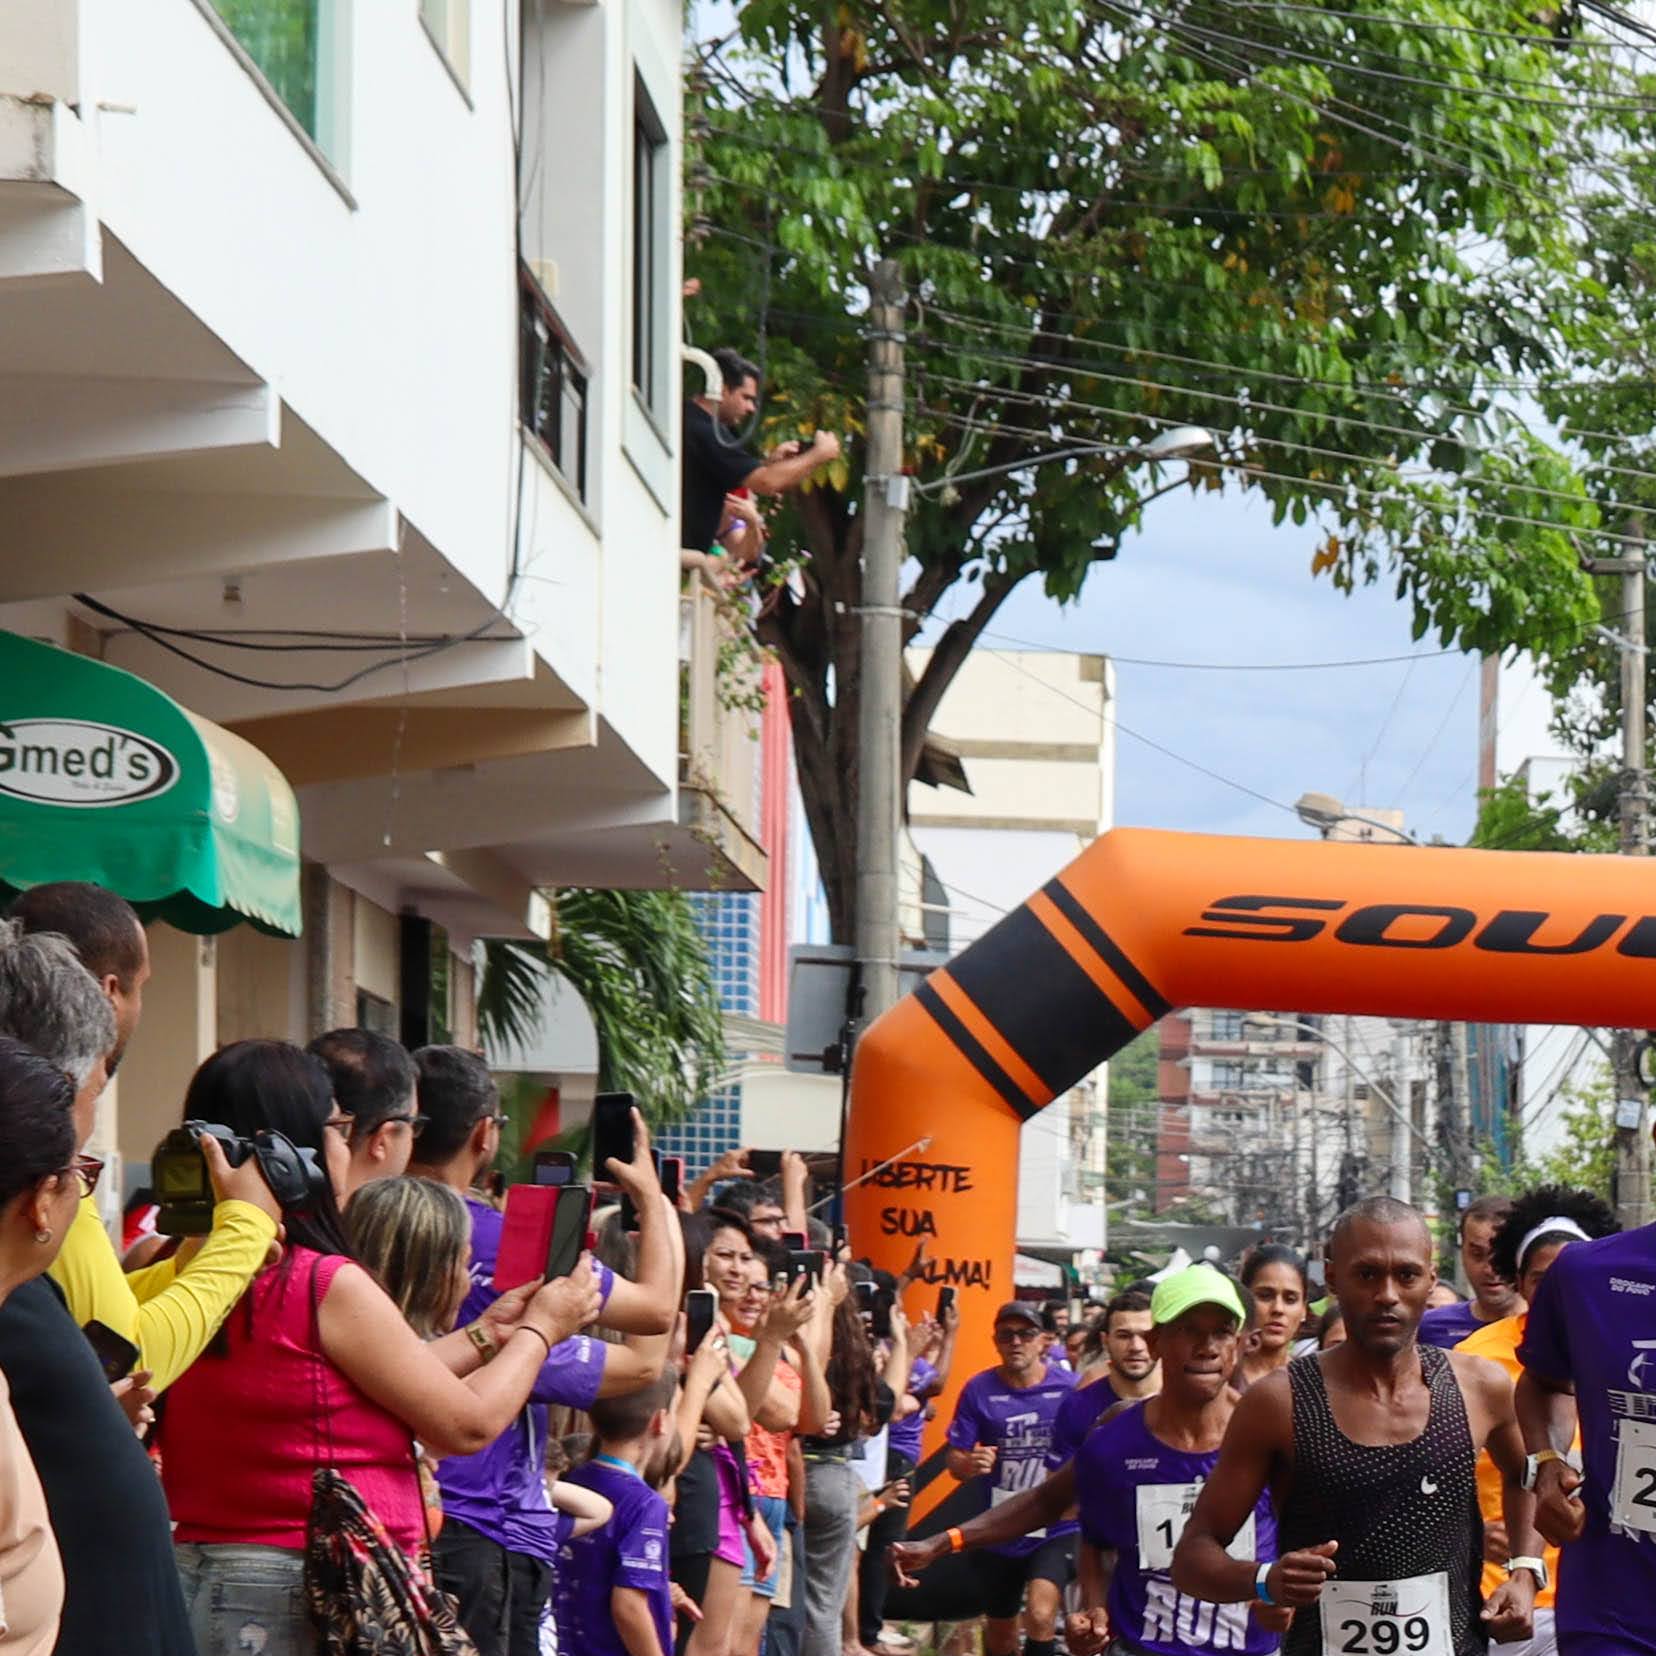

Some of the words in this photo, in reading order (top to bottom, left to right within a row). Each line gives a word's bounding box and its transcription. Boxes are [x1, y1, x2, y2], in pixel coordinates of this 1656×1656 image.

[880, 1206, 938, 1238] SUA
[1370, 1602, 1399, 1616] RUN
[1340, 1616, 1430, 1655] 299
